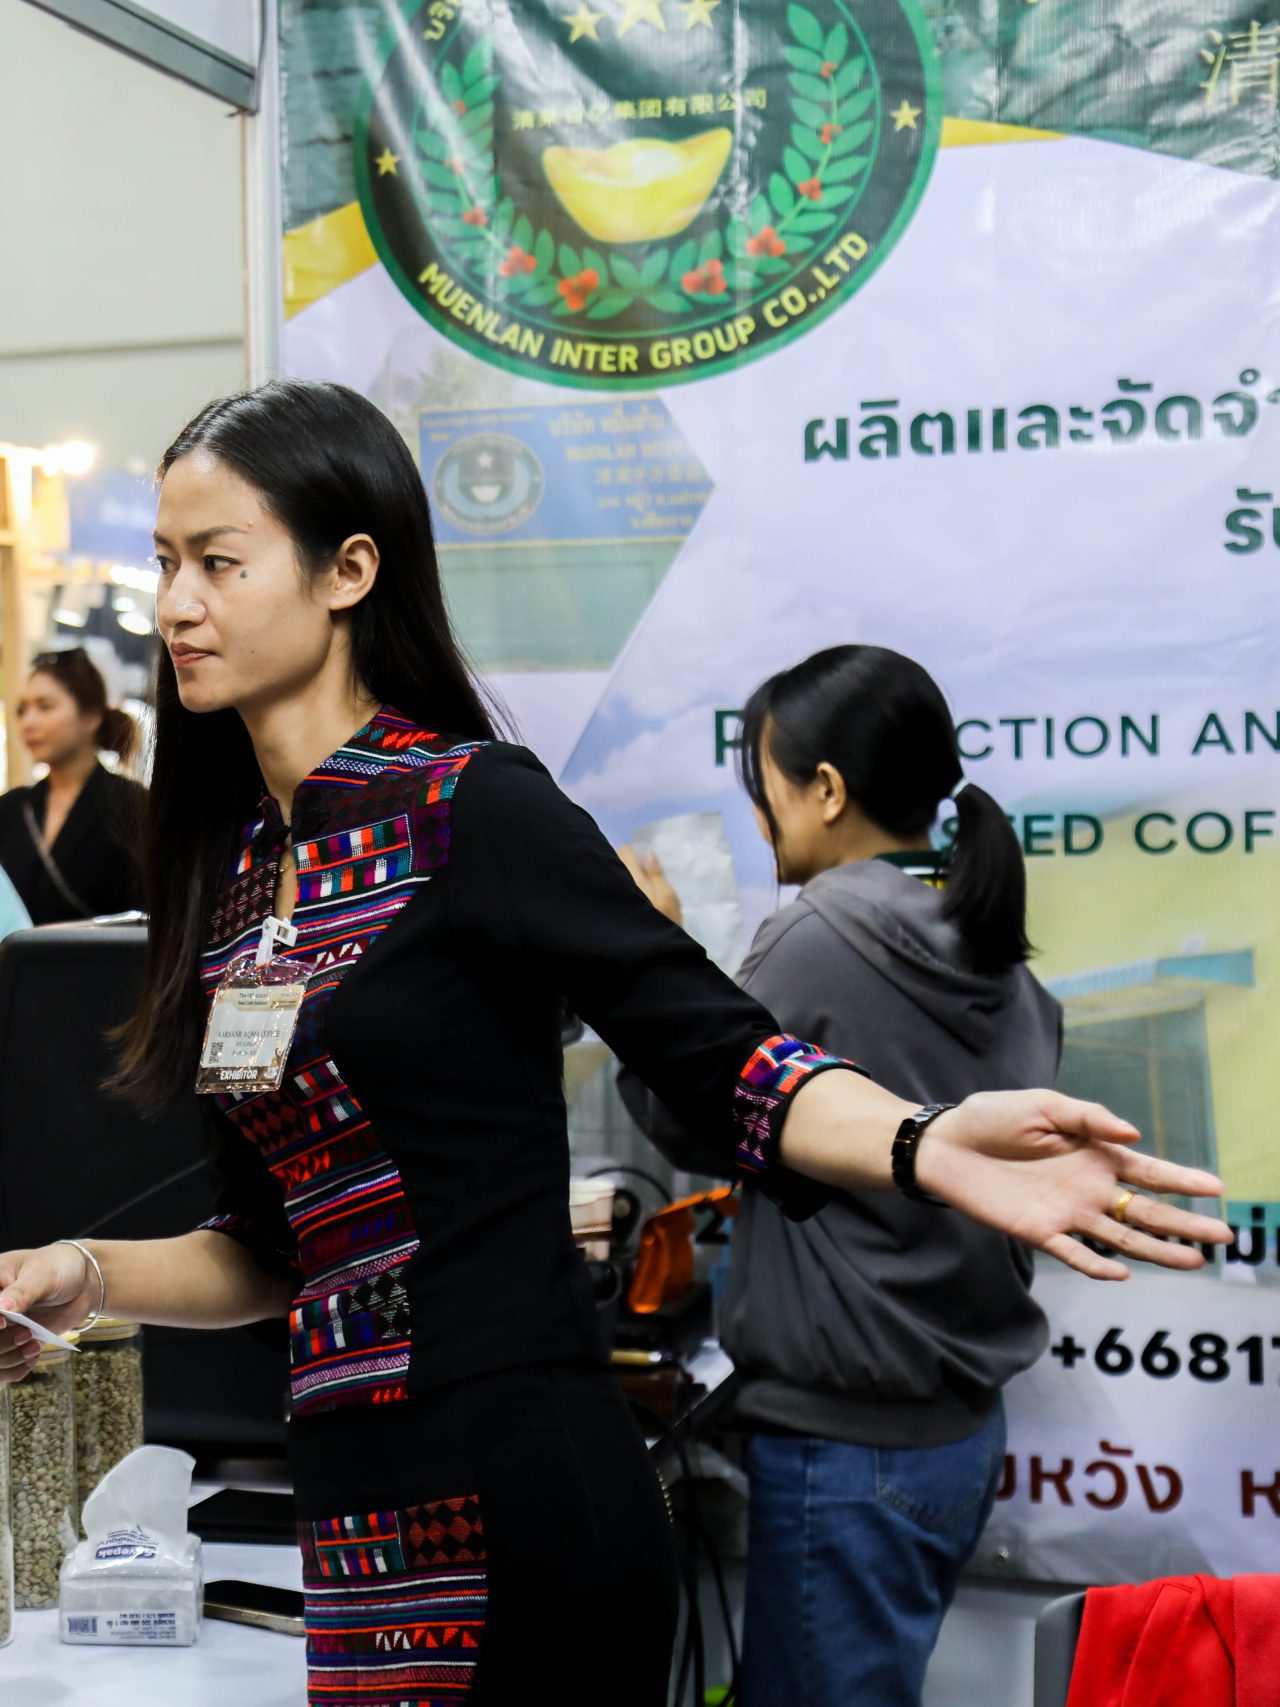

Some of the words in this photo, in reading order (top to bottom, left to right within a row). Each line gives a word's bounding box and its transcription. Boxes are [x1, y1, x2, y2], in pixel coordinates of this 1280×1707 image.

[418, 262, 545, 359] MUENLAN
[550, 338, 639, 373] INTER
[649, 315, 756, 370] GROUP
[714, 709, 1160, 768] PCTION
[1051, 1328, 1280, 1387] +6681
